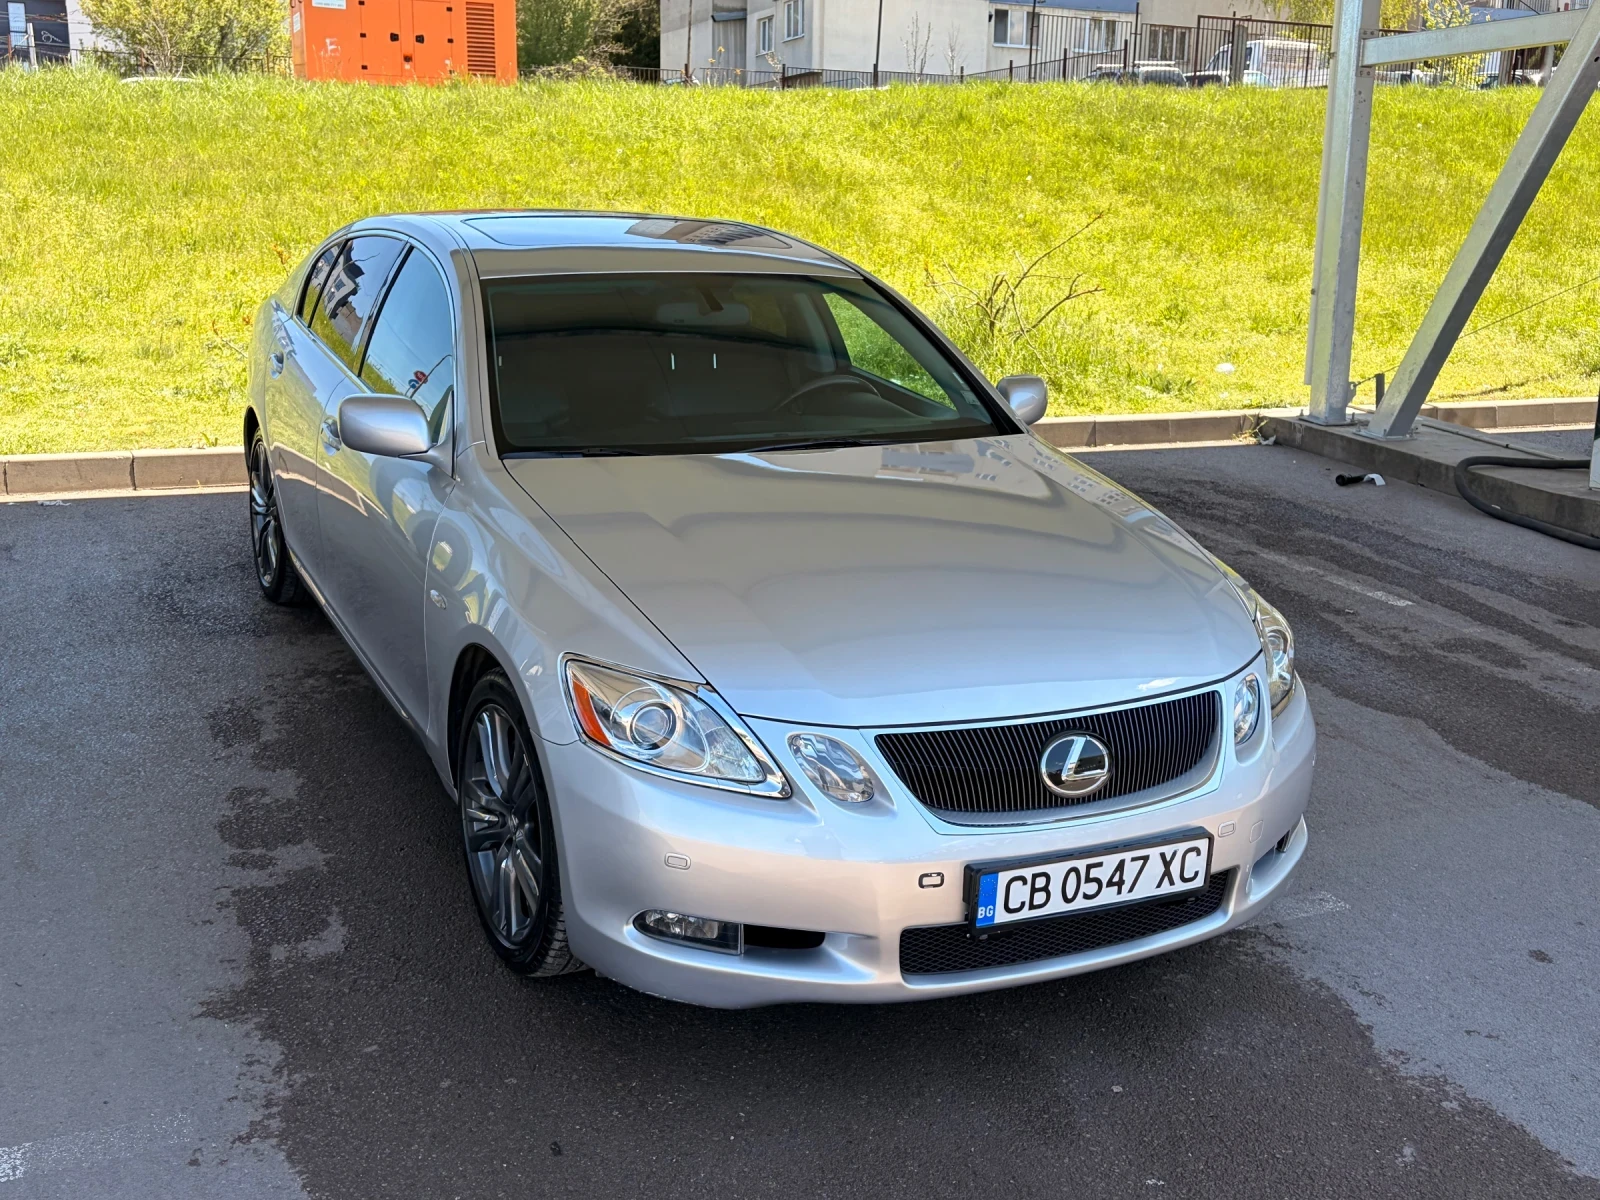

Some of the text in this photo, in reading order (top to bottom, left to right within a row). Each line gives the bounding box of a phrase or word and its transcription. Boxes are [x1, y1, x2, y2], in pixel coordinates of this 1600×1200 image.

[1003, 846, 1202, 915] CB 0547 XC
[977, 904, 994, 919] BG
